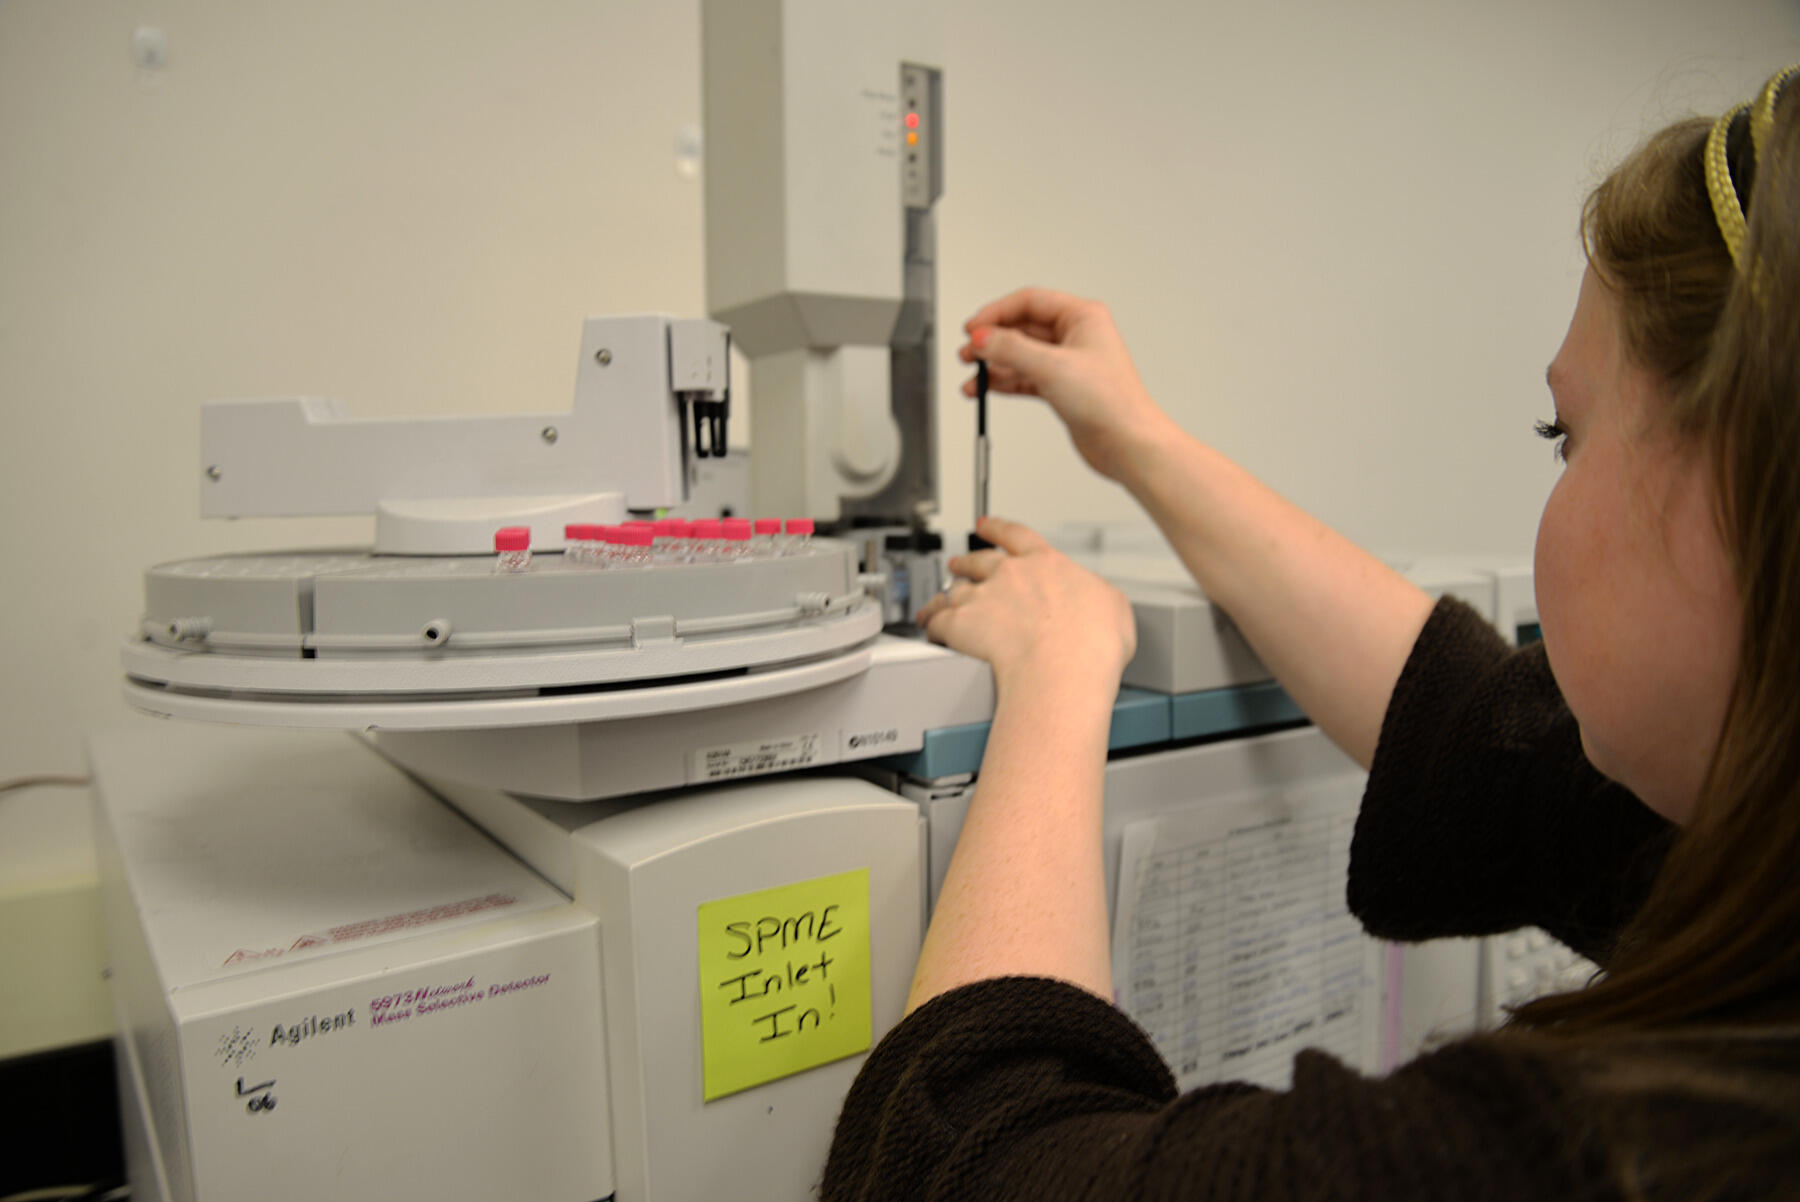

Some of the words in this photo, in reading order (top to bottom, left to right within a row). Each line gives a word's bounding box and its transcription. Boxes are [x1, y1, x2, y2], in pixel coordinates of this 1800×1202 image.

[725, 904, 843, 960] SPME
[416, 990, 485, 1014] Selective
[487, 972, 552, 999] Detector
[718, 951, 834, 1006] Inlet
[269, 1008, 355, 1047] Agilent
[751, 983, 836, 1043] In!
